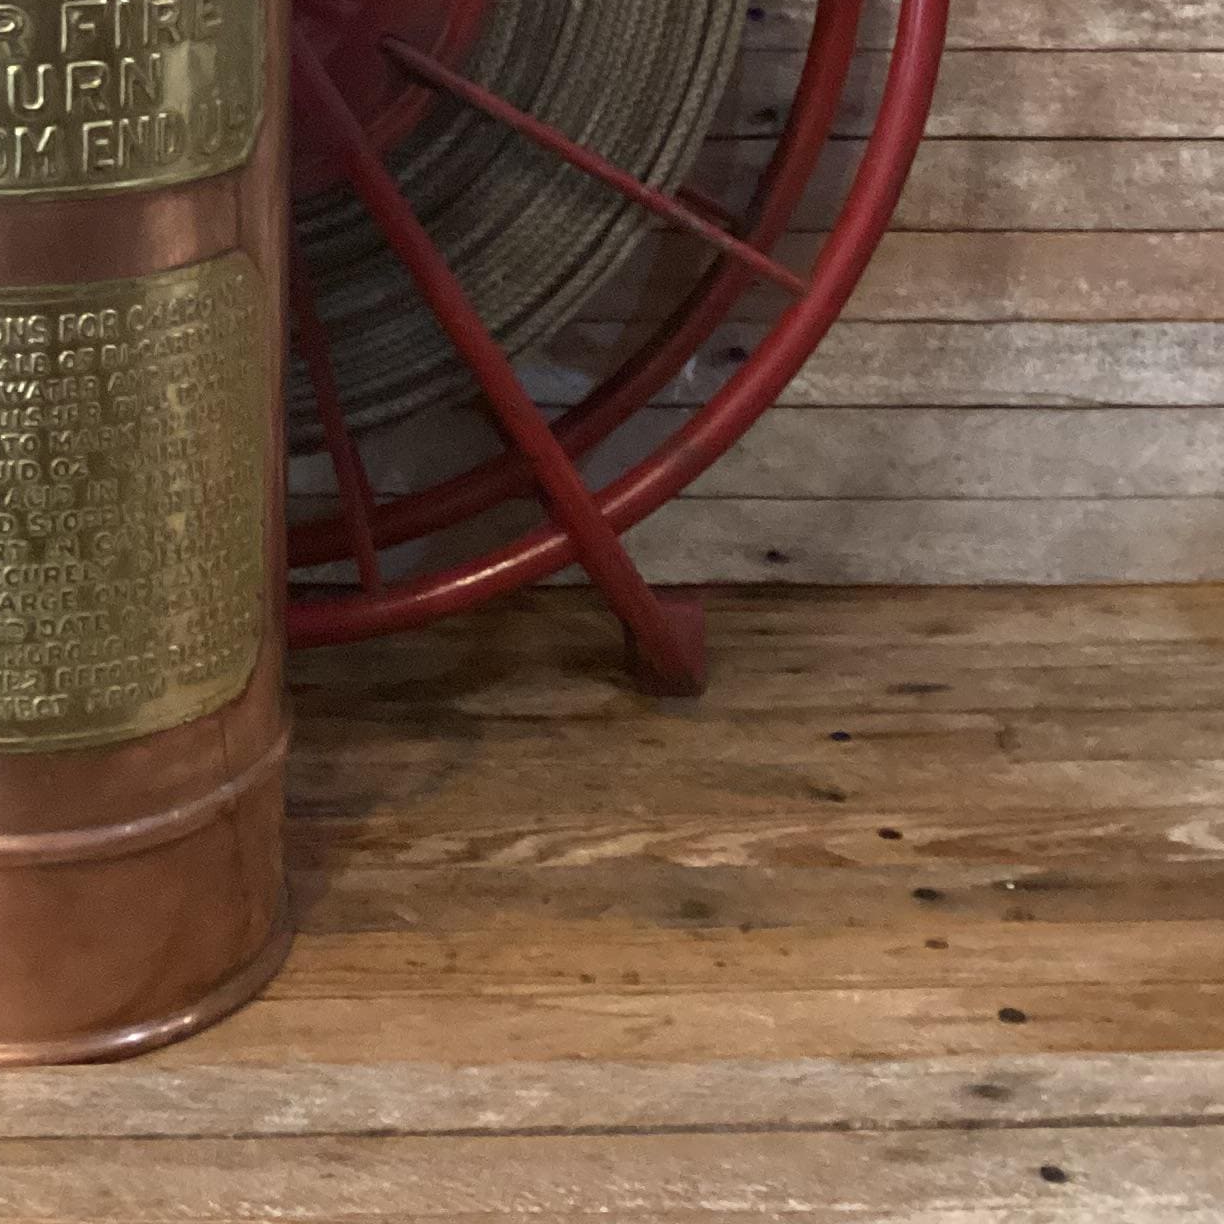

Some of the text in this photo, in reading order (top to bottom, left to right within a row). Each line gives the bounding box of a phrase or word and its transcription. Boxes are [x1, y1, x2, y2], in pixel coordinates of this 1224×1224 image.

[82, 110, 186, 173] END
[58, 308, 119, 343] FOR
[0, 432, 40, 455] TO
